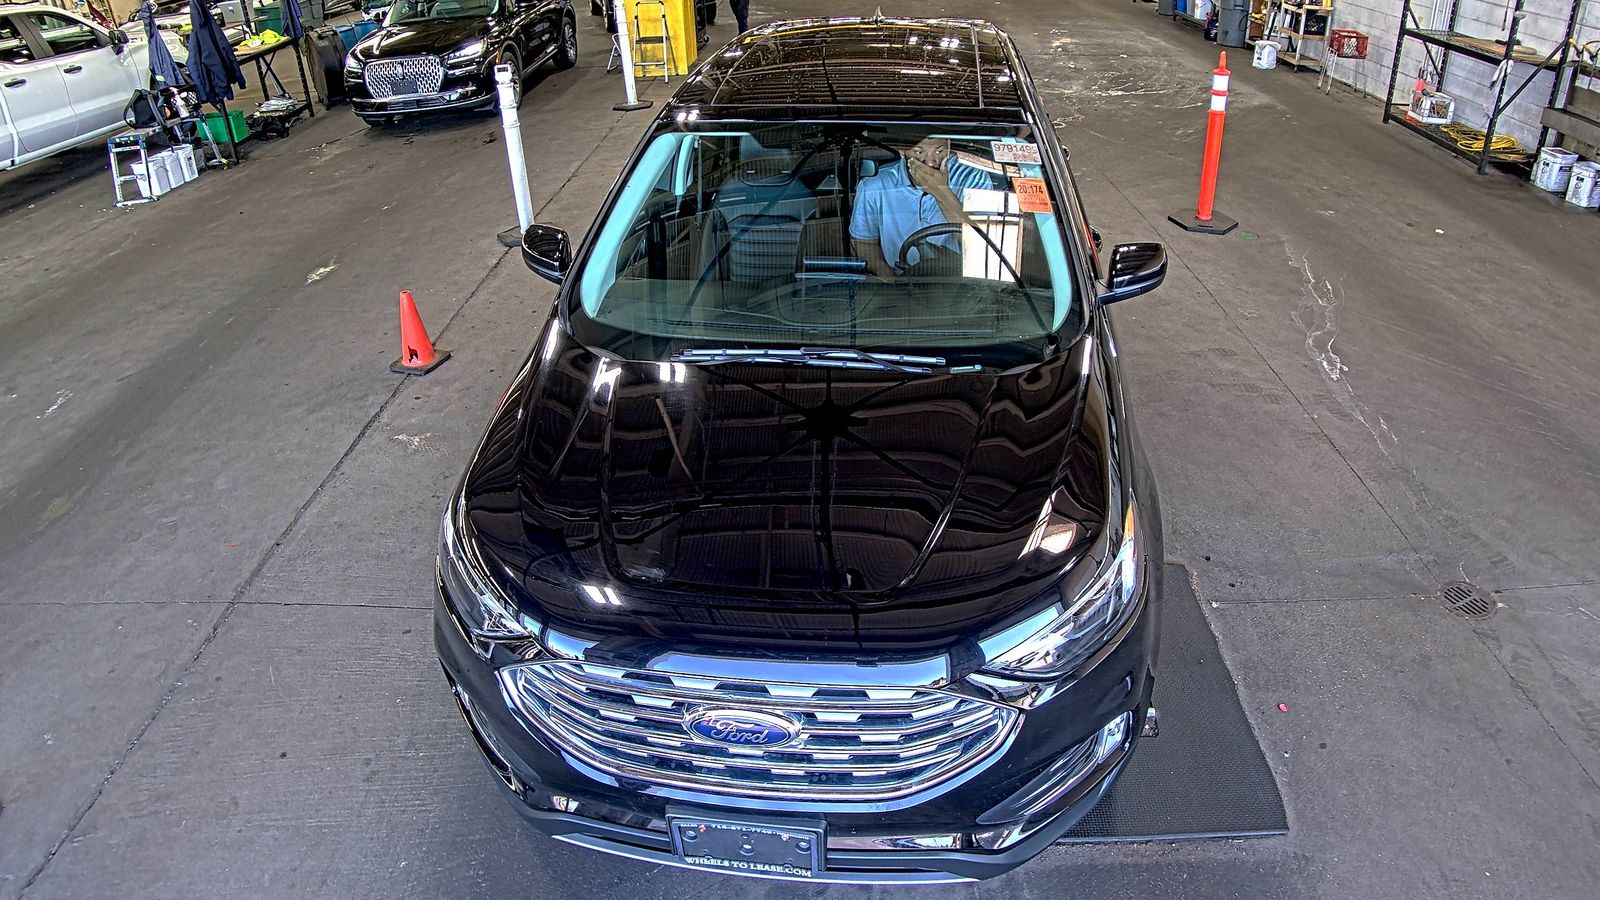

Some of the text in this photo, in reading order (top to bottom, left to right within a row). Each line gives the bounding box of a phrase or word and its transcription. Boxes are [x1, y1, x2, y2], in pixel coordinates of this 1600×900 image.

[711, 720, 768, 743] Ford
[685, 857, 812, 877] WHEELS TO LEASE.COM
